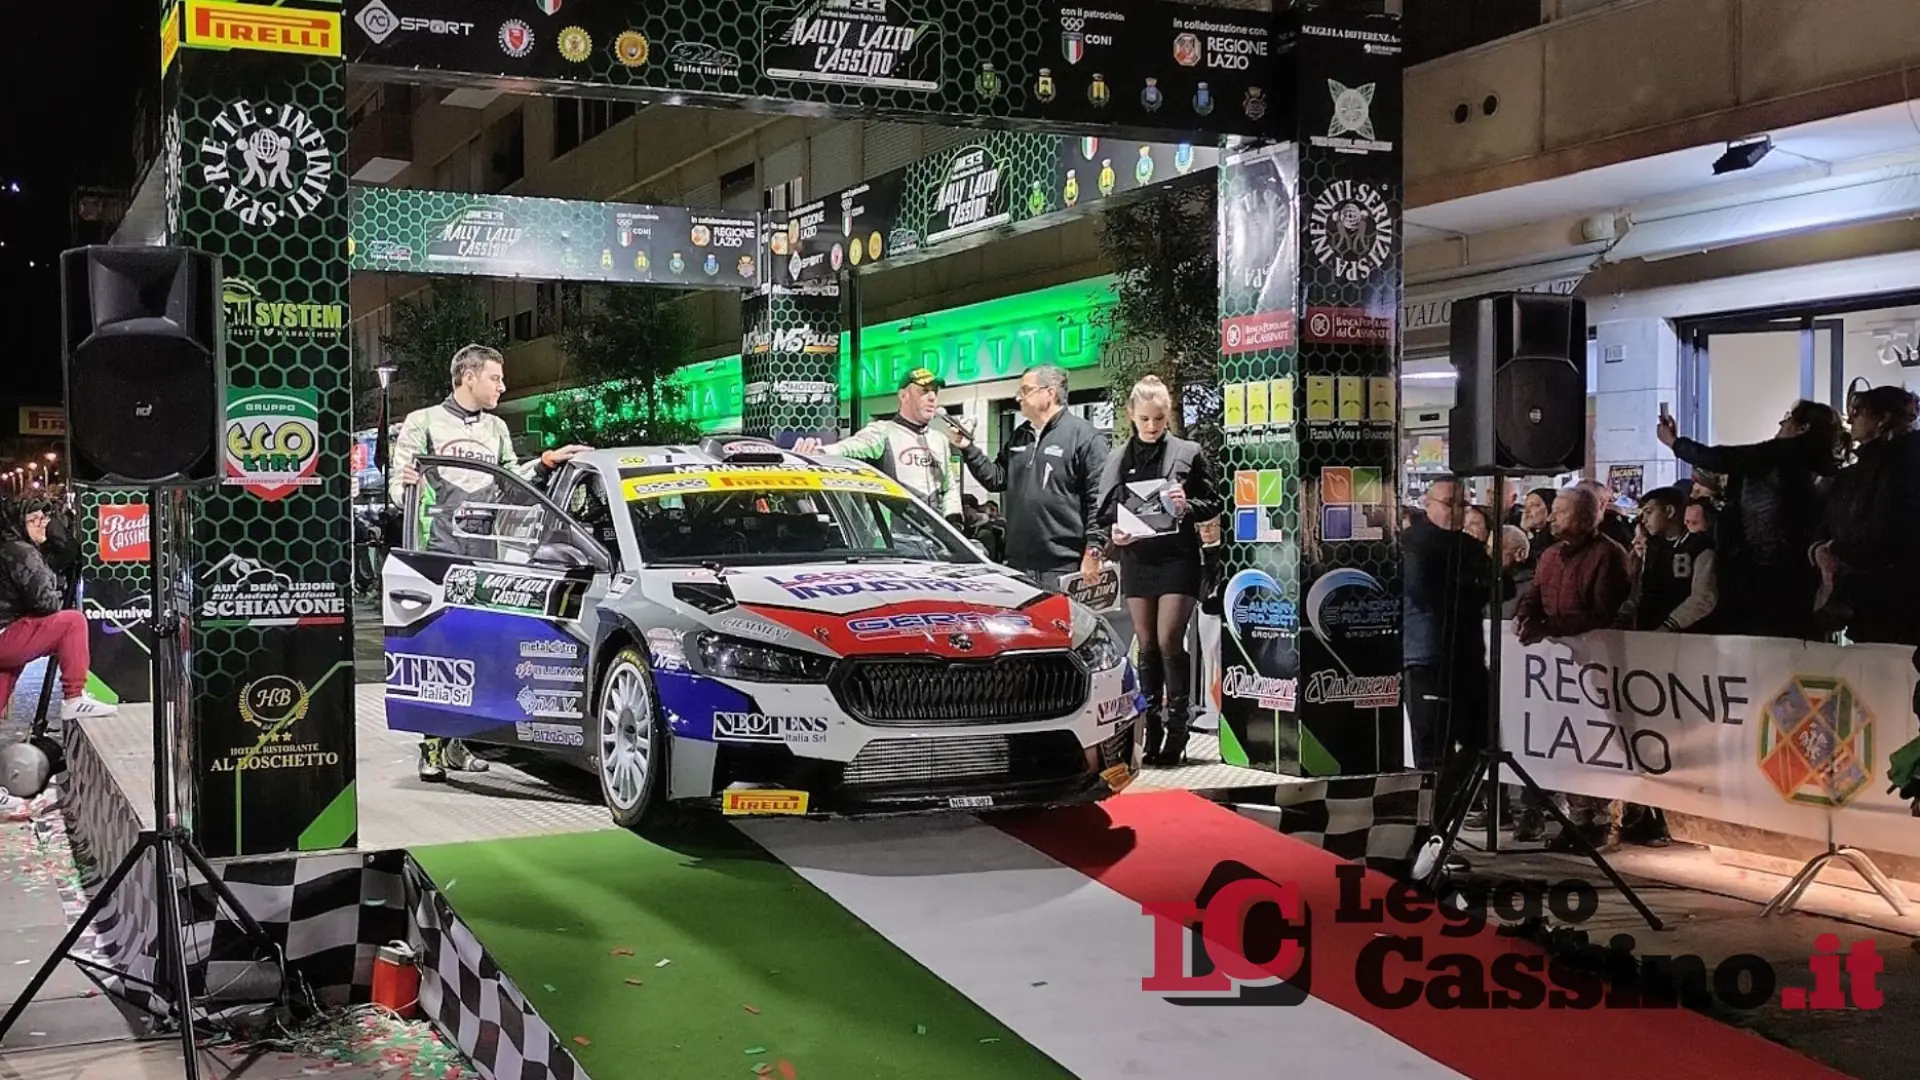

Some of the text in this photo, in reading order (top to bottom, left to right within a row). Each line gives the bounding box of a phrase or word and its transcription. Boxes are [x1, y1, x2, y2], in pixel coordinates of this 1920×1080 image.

[195, 8, 332, 48] PIRELLI
[791, 17, 916, 51] RALLY LAZIO
[1085, 34, 1112, 45] CONI
[1207, 36, 1268, 56] REGIONE
[814, 46, 894, 77] CASSINO
[1207, 52, 1249, 70] LAZIO
[443, 224, 481, 241] RALLY
[714, 227, 755, 239] REGIONE
[1310, 179, 1393, 281] INFINITI SERVIZI SPA
[714, 239, 742, 247] LAZIO
[255, 303, 342, 328] SYSTEM
[245, 403, 296, 412] GRUPPO
[242, 453, 301, 473] LIRI
[721, 476, 810, 487] PIRELLI
[101, 513, 150, 534] Radi
[292, 590, 336, 599] Alfonso
[201, 598, 345, 617] SCHIAVONE
[420, 684, 471, 704] Italia Srl
[1524, 653, 1748, 725] REGIONE
[715, 712, 829, 735] NEOTENS
[785, 733, 828, 743] Italia Srl
[1523, 711, 1671, 775] LAZIO
[263, 743, 320, 754] RISTORANTE
[210, 752, 339, 771] AL BOSCHETTO
[730, 795, 799, 810] PIRELLI
